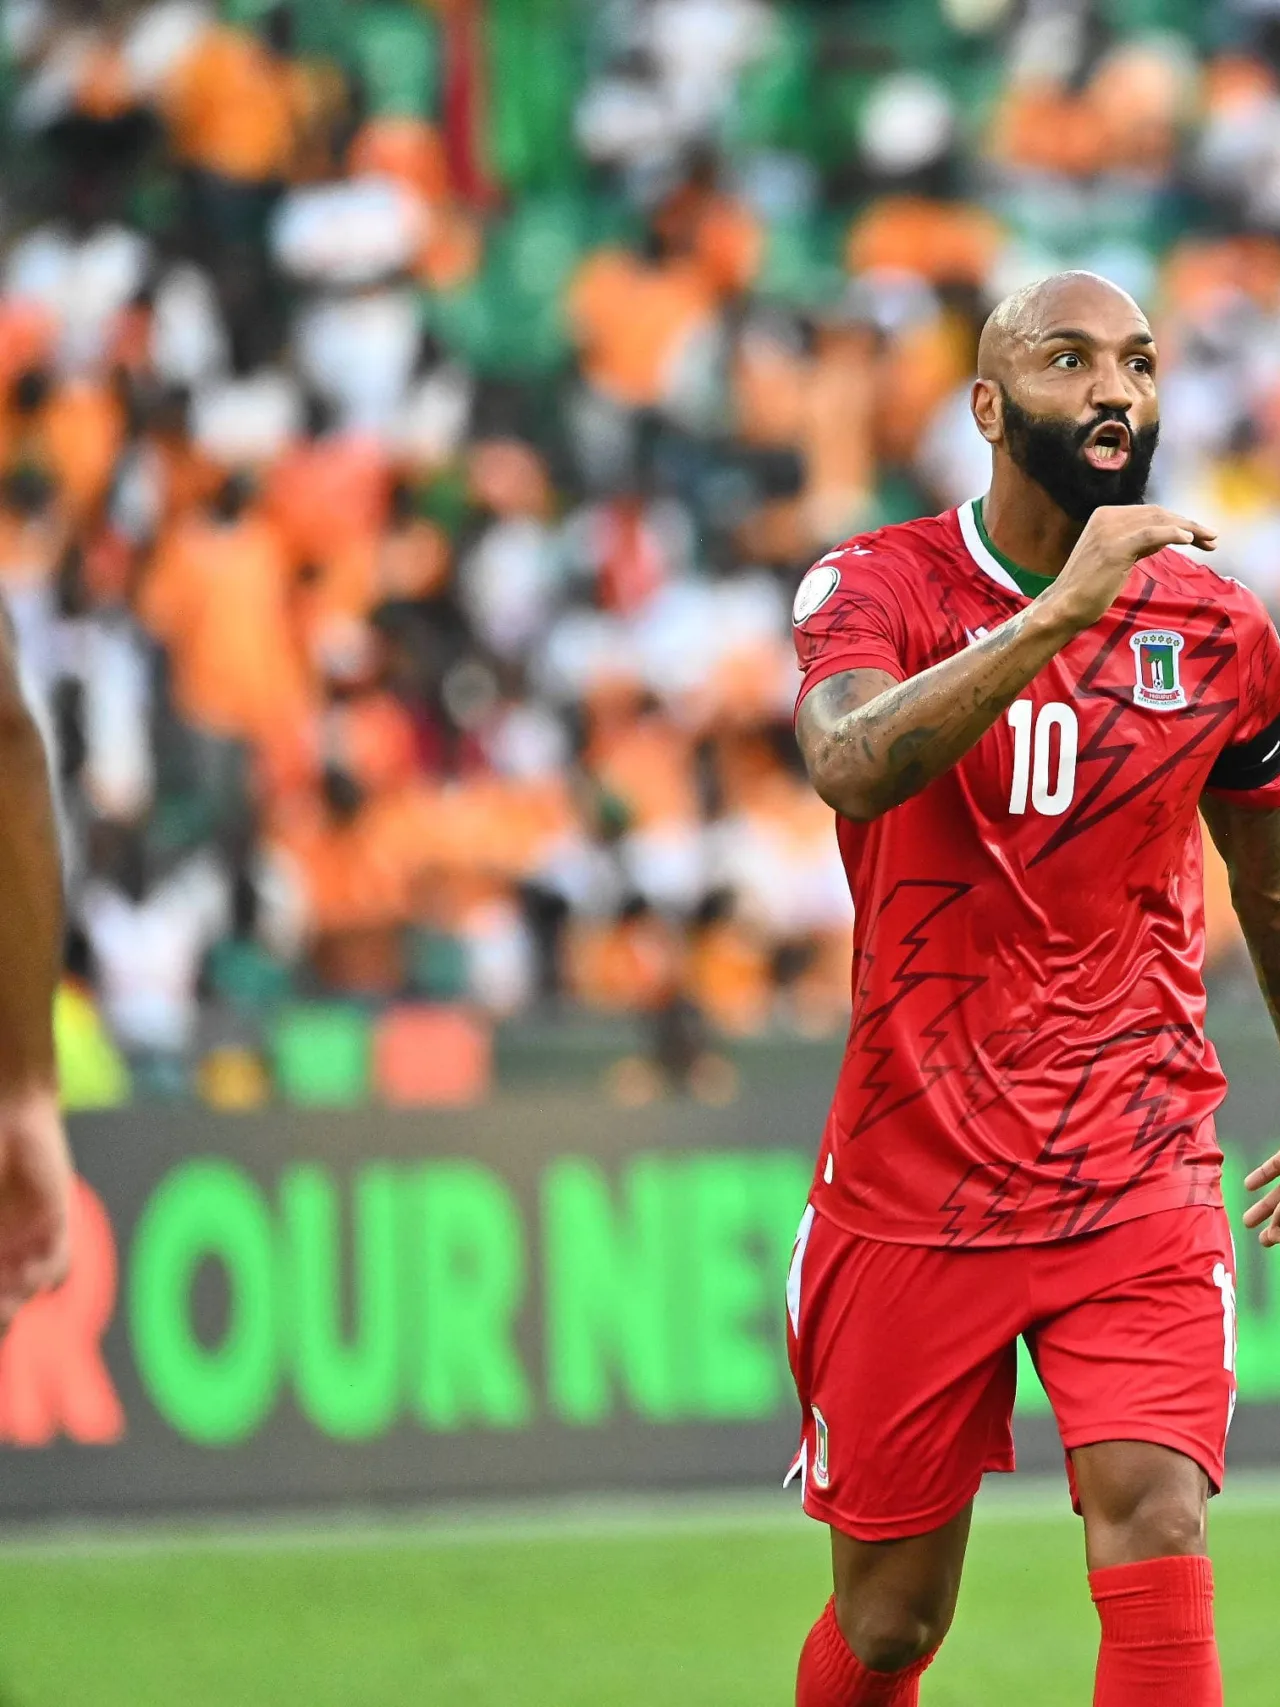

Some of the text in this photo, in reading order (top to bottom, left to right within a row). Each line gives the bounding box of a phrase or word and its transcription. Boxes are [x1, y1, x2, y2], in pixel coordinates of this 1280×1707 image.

[1007, 699, 1079, 816] 10
[128, 1158, 529, 1444] OUR
[540, 1151, 818, 1424] NE
